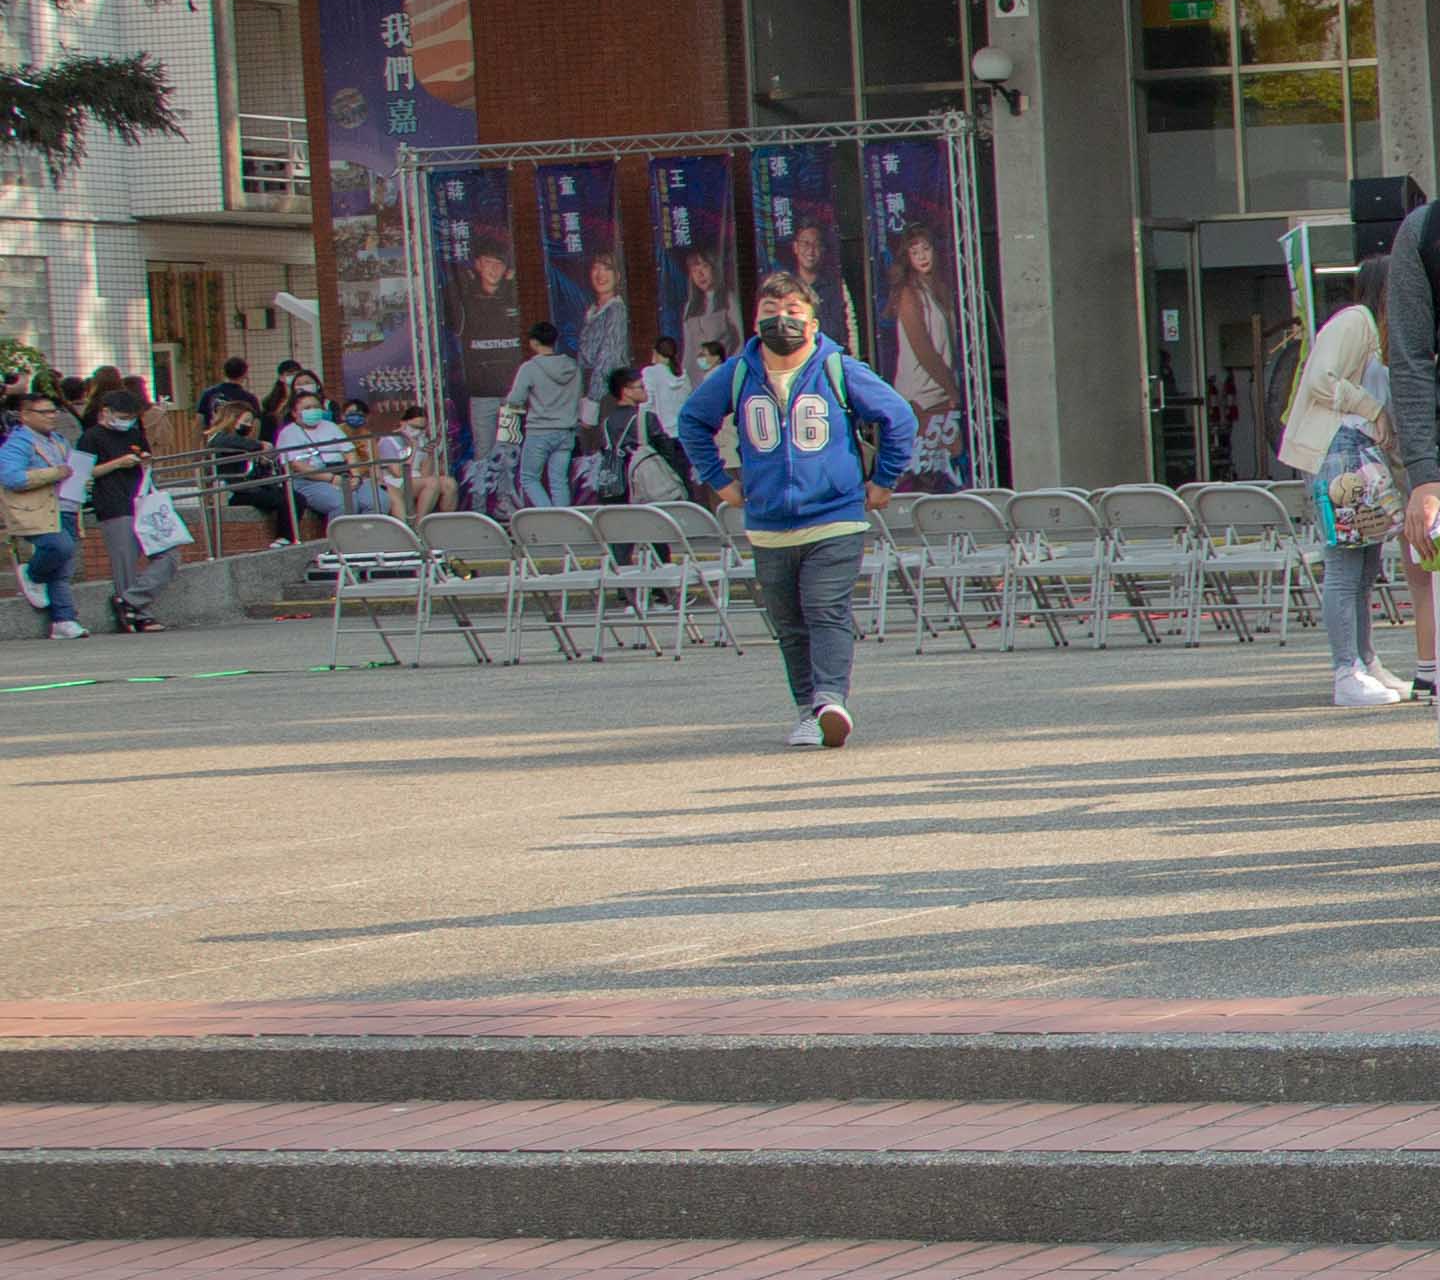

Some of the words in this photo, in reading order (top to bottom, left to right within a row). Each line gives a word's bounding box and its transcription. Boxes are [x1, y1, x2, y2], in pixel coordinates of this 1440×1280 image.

[768, 156, 788, 177] 張
[669, 169, 687, 188] 王
[744, 394, 831, 453] 06
